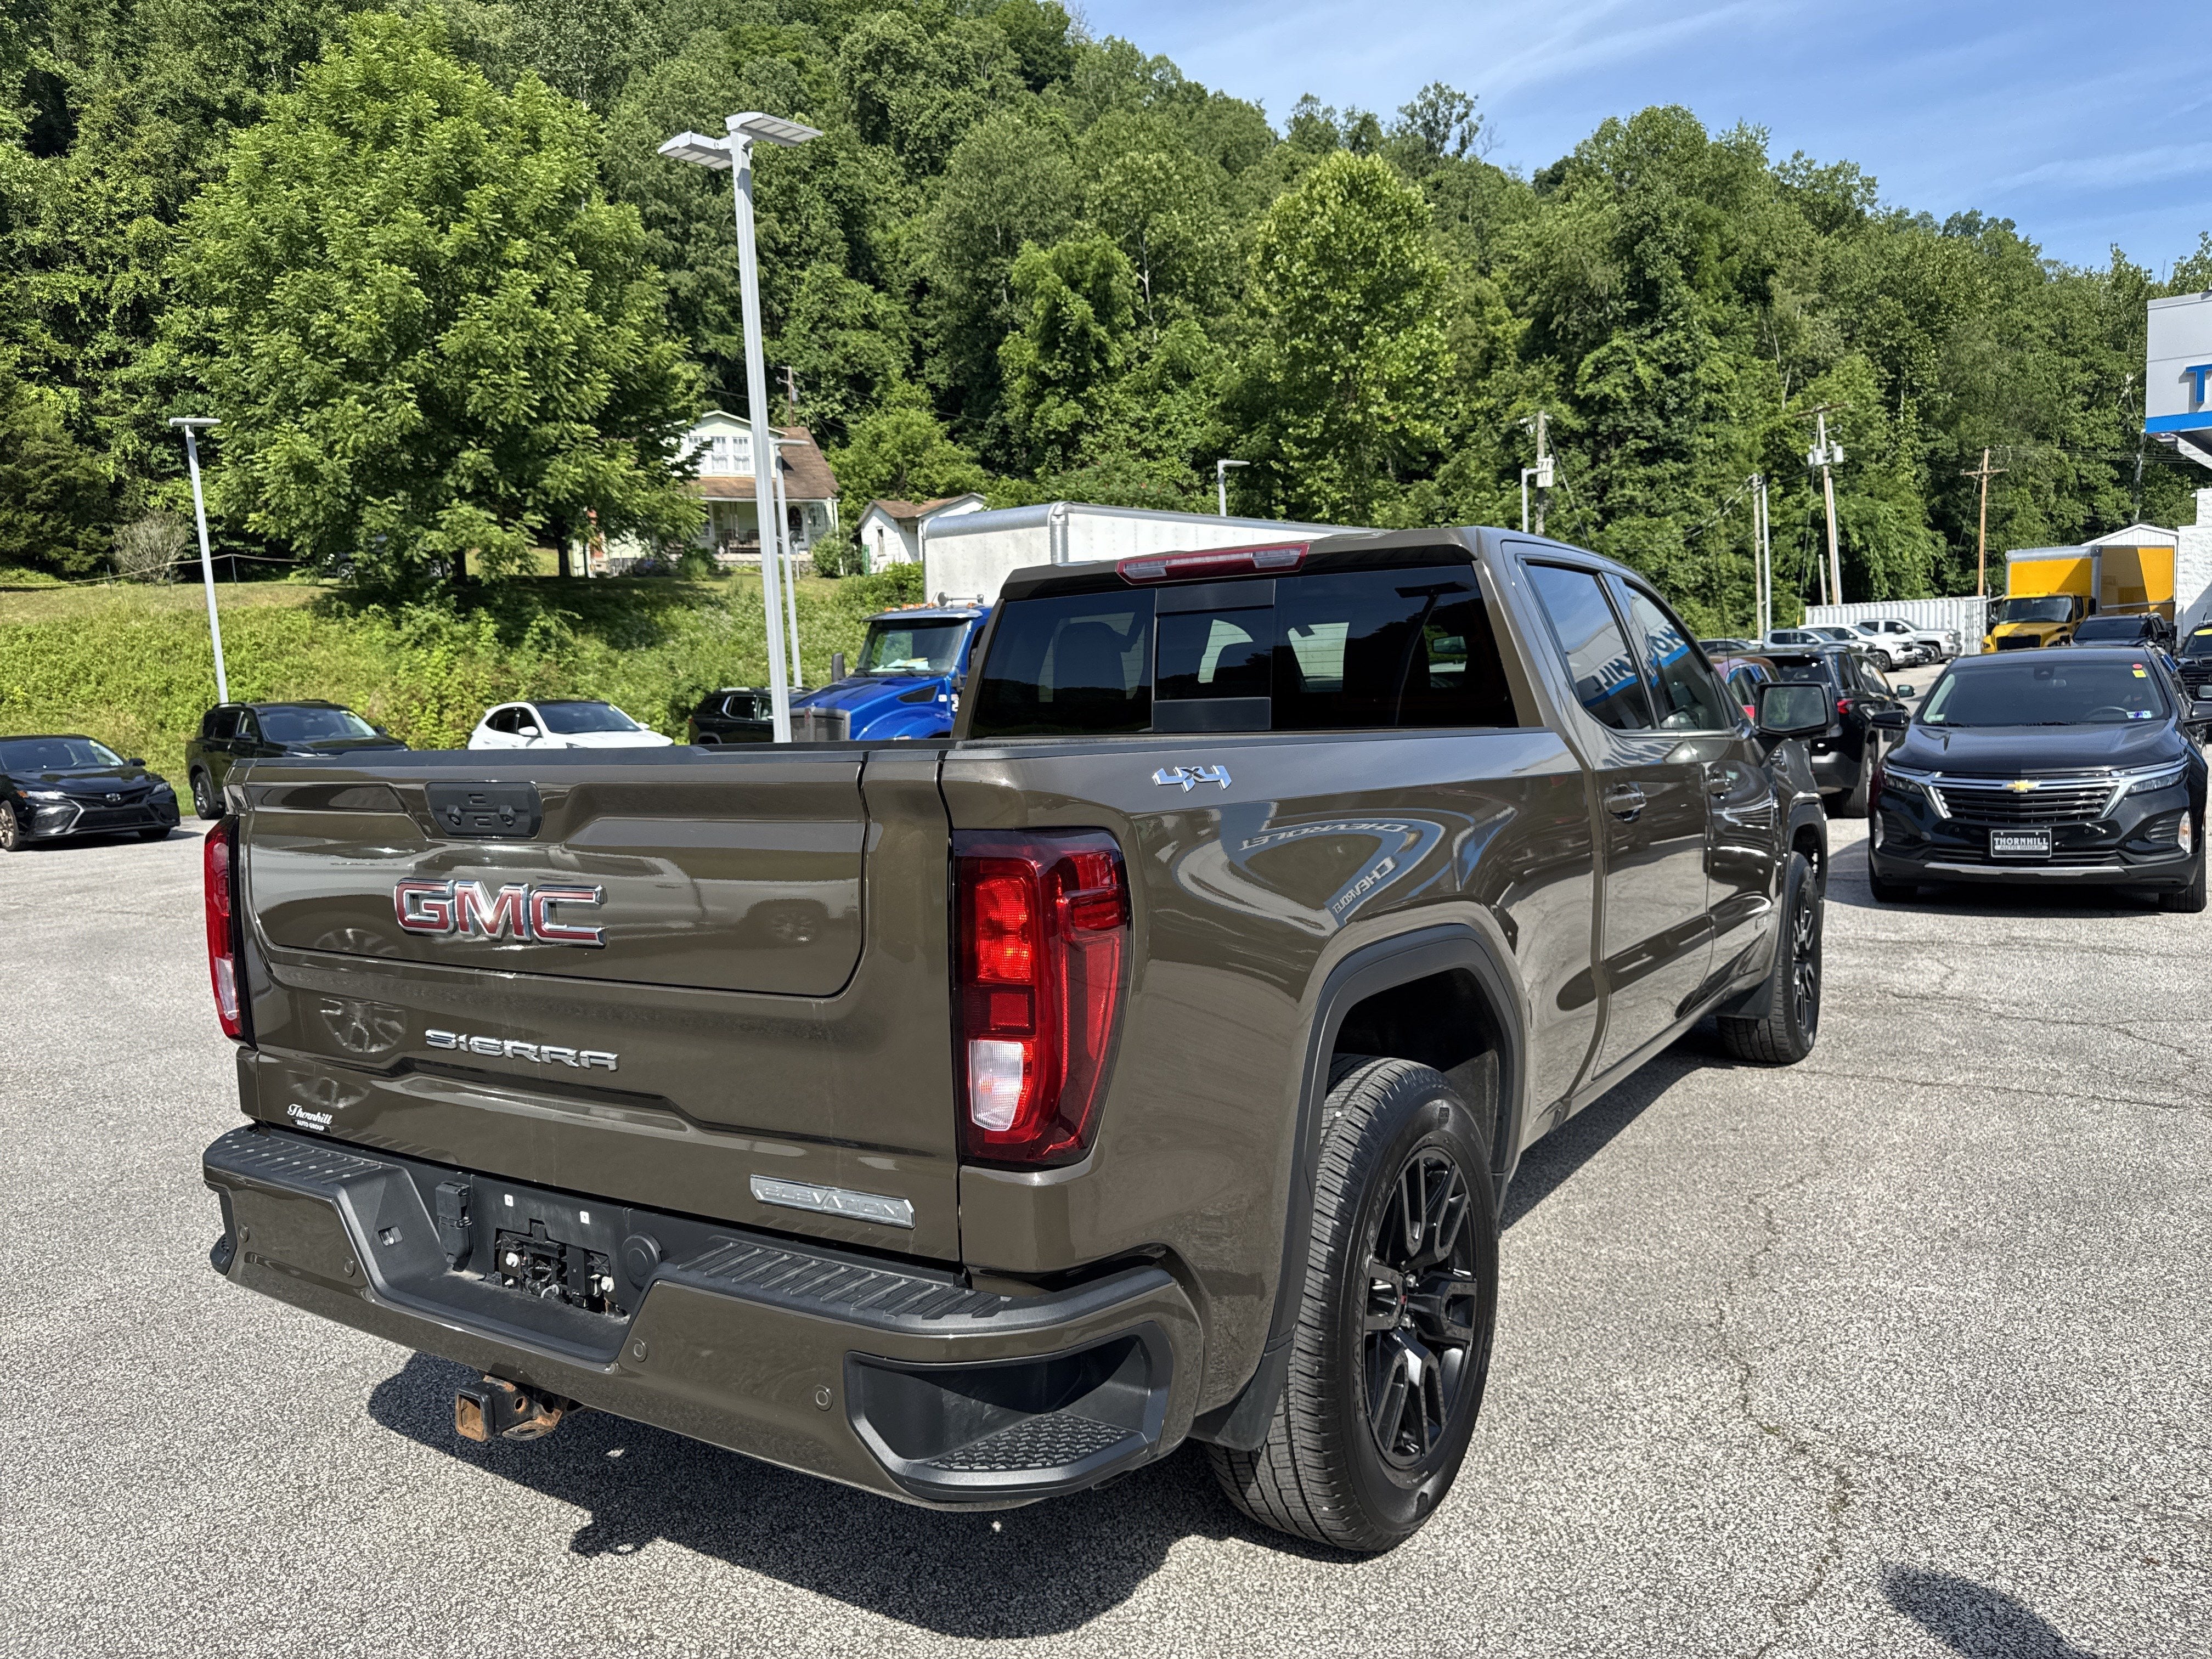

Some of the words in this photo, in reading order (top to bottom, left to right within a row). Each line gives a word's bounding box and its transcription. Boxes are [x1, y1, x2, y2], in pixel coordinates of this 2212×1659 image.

[1994, 837, 2049, 845] THORNHILL
[394, 878, 606, 947] GMC
[425, 1029, 619, 1072] SIERRA
[287, 1103, 333, 1125] Thornhill
[297, 1119, 309, 1128] AUTO
[309, 1122, 325, 1131] GROUP
[763, 1183, 901, 1217] ELEVATION
